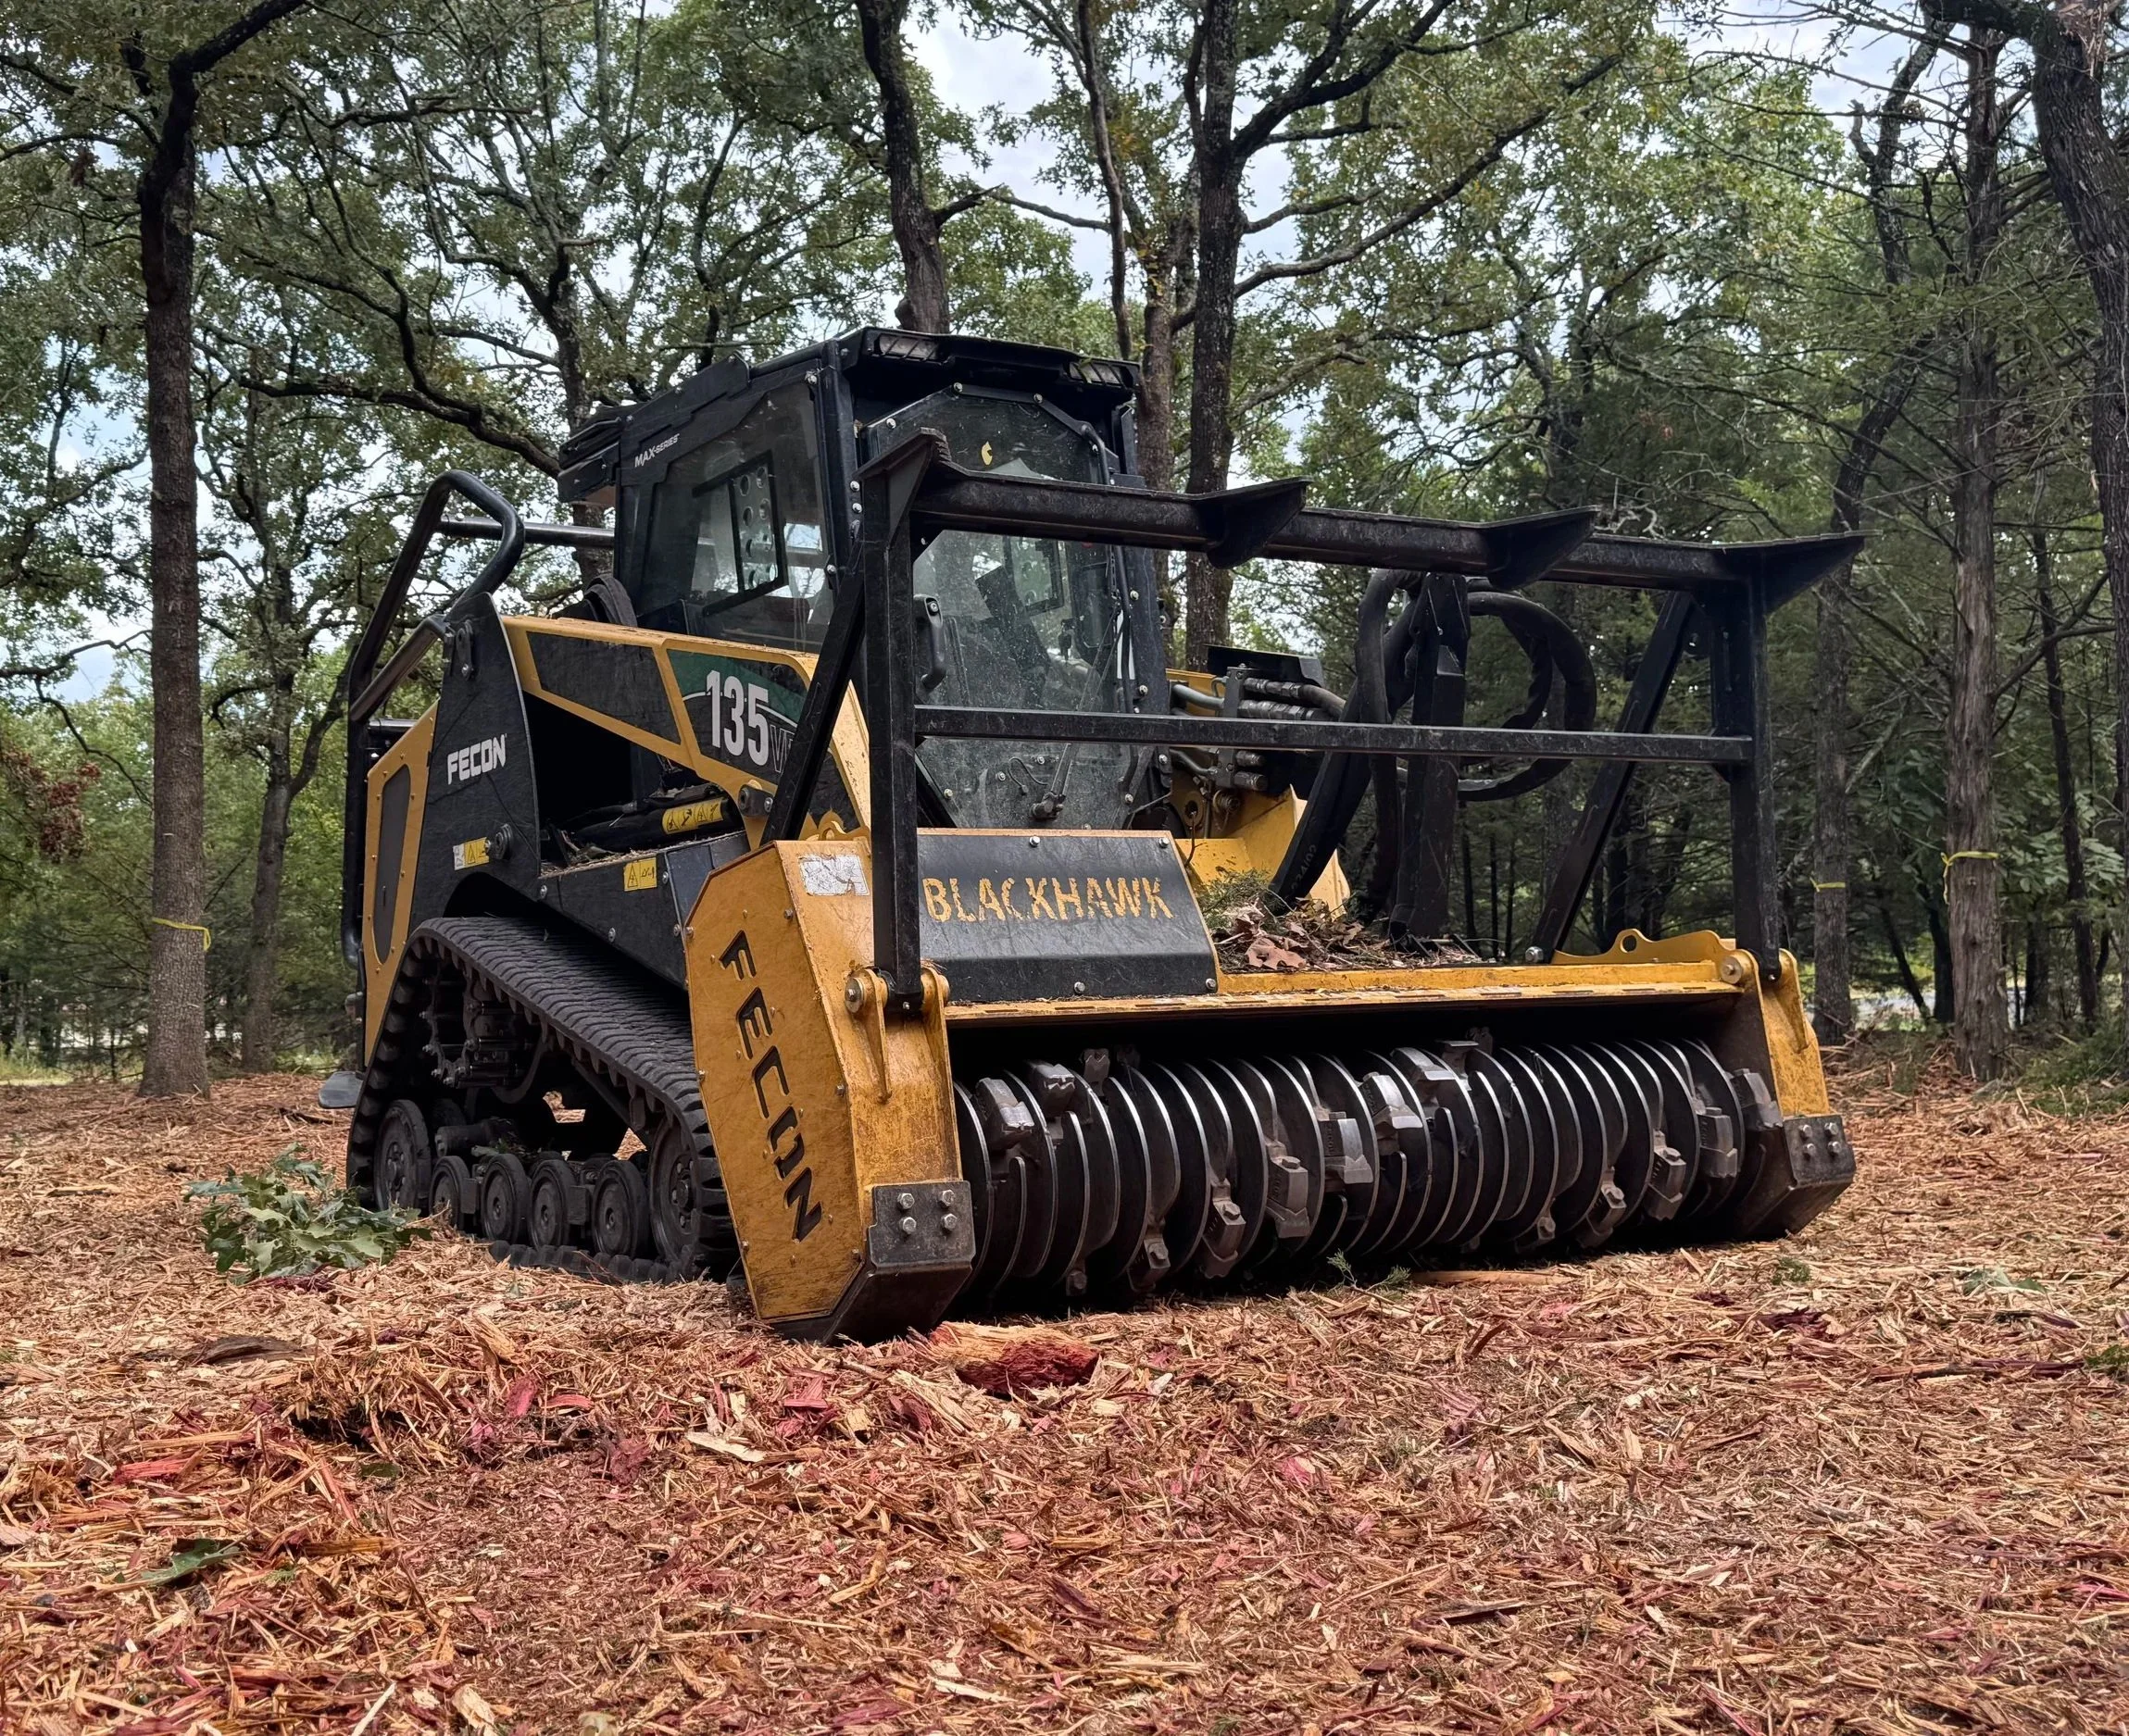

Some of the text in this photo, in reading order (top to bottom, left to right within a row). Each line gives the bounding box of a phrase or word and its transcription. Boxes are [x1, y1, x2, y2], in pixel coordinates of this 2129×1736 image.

[447, 734, 507, 785] FECON
[922, 878, 1174, 922] BLACKHAWK
[719, 930, 822, 1243] FECON
